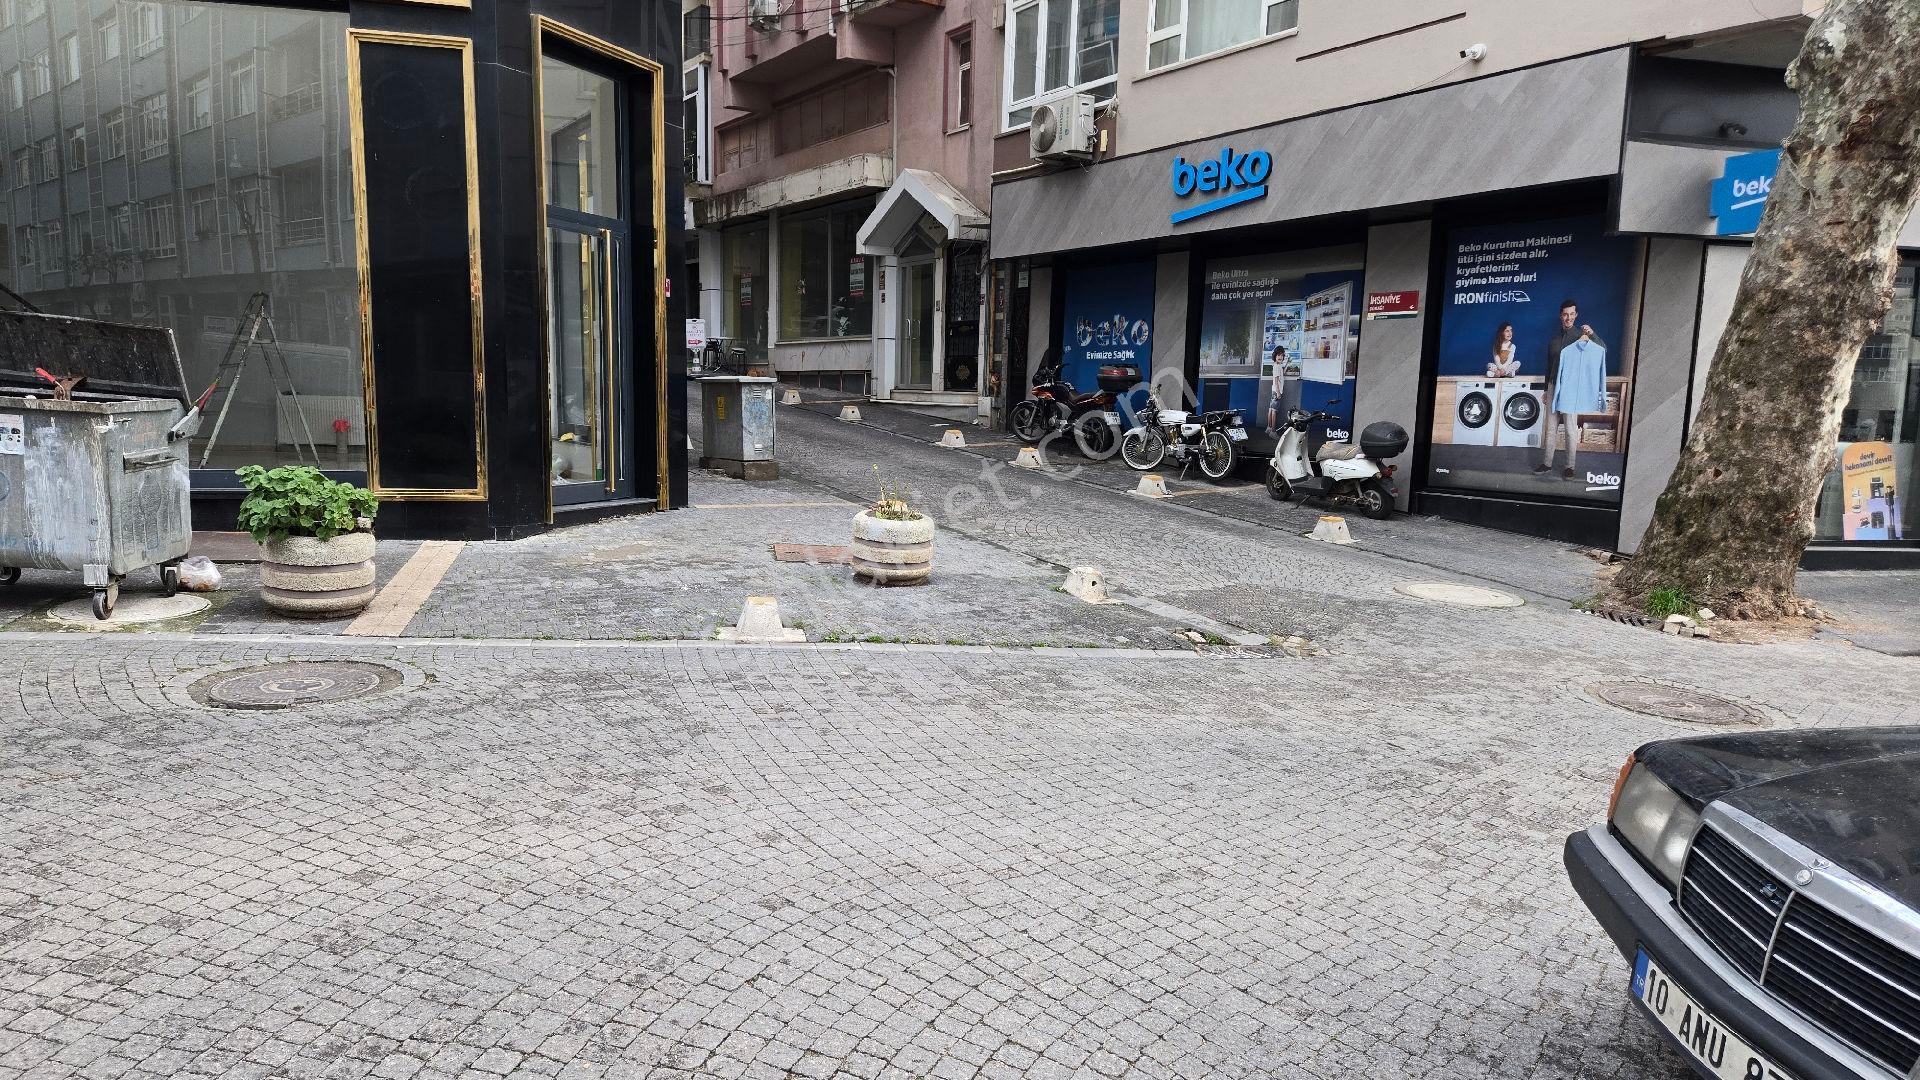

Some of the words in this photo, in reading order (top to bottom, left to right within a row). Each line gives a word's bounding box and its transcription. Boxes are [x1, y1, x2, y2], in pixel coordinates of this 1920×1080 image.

[1173, 147, 1271, 196] beko
[1733, 175, 1773, 197] bek
[1458, 244, 1482, 253] Beko
[1483, 240, 1524, 250] Kurutma
[1526, 234, 1572, 247] Makinesi
[1458, 254, 1474, 264] ütü
[1475, 253, 1494, 265] işini
[1496, 251, 1527, 261] sizden
[1529, 248, 1548, 259] alır,
[1456, 262, 1520, 276] kıyafetleriniz
[1455, 277, 1488, 288] giyime
[1488, 276, 1512, 284] hazır
[1514, 272, 1537, 283] olur!
[1211, 292, 1228, 301] daha
[1229, 290, 1241, 301] çok
[1242, 290, 1255, 300] yer
[1454, 290, 1515, 305] IRONfinish
[1077, 314, 1149, 347] beko
[1326, 428, 1349, 439] beko
[1586, 471, 1620, 486] beko
[1648, 968, 1669, 1015] 10
[1679, 1003, 1727, 1069] ANU
